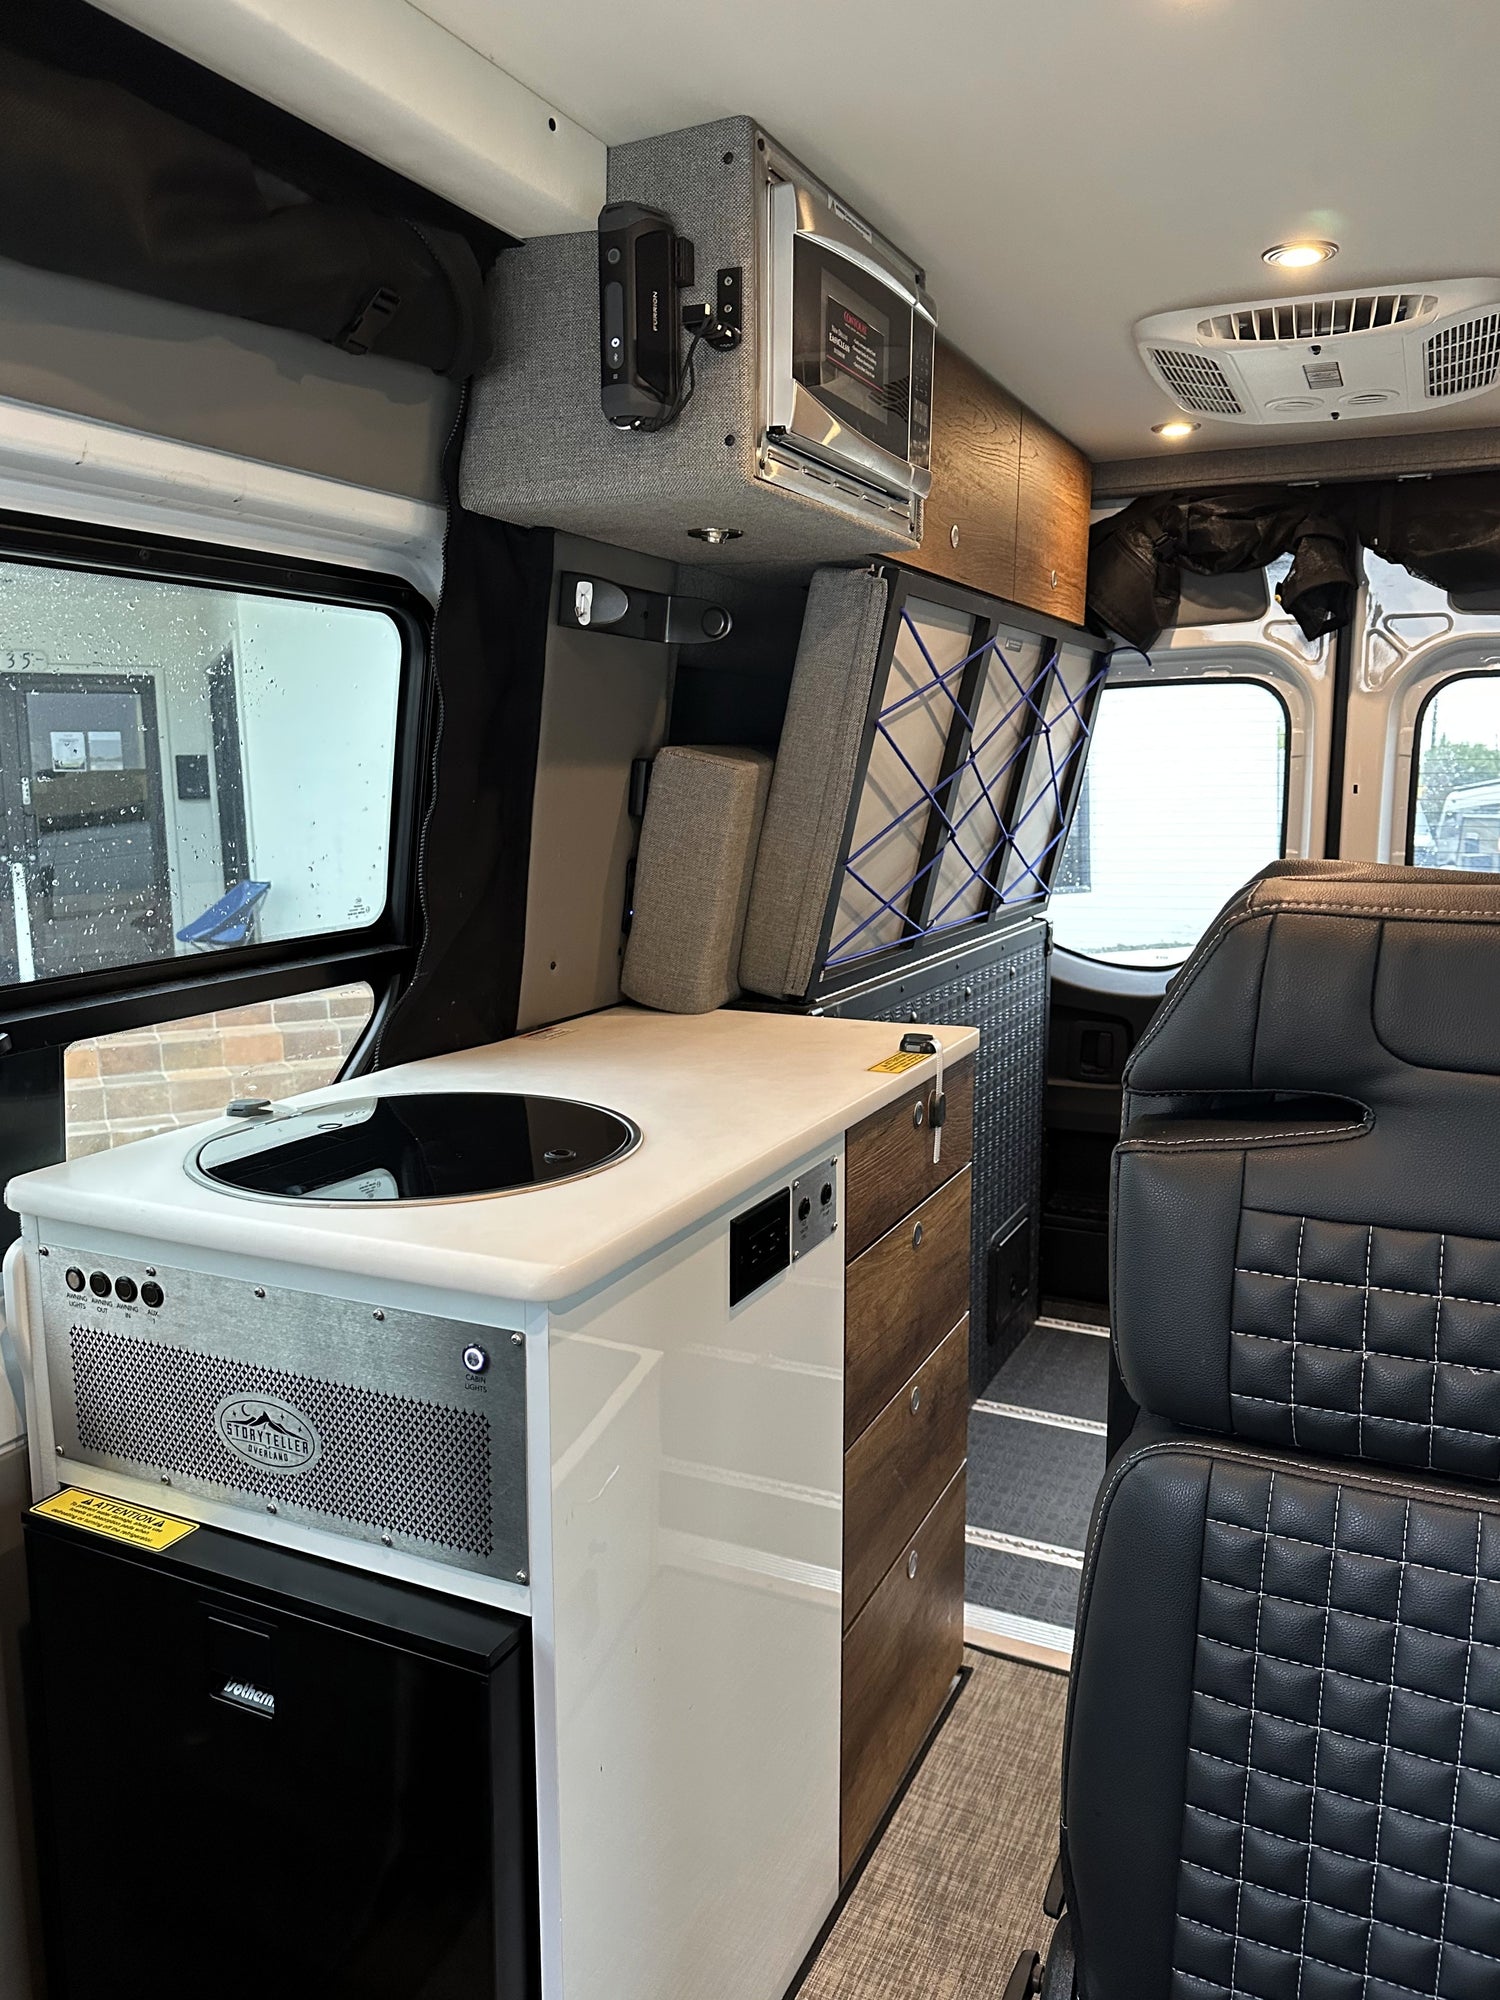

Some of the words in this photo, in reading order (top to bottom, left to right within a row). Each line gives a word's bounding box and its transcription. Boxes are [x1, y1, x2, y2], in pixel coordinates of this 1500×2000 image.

[66, 1292, 88, 1303] AWNING
[91, 1297, 113, 1308] AWNING
[68, 1300, 87, 1310] LIGHTS
[96, 1306, 108, 1315] OUT
[116, 1302, 139, 1313] AWNING
[465, 1373, 486, 1384] CABIN
[464, 1383, 488, 1393] LIGHTS
[226, 1422, 309, 1455] STORYTELLER
[248, 1444, 289, 1462] OVERLAND
[92, 1501, 157, 1524] ATTENTION
